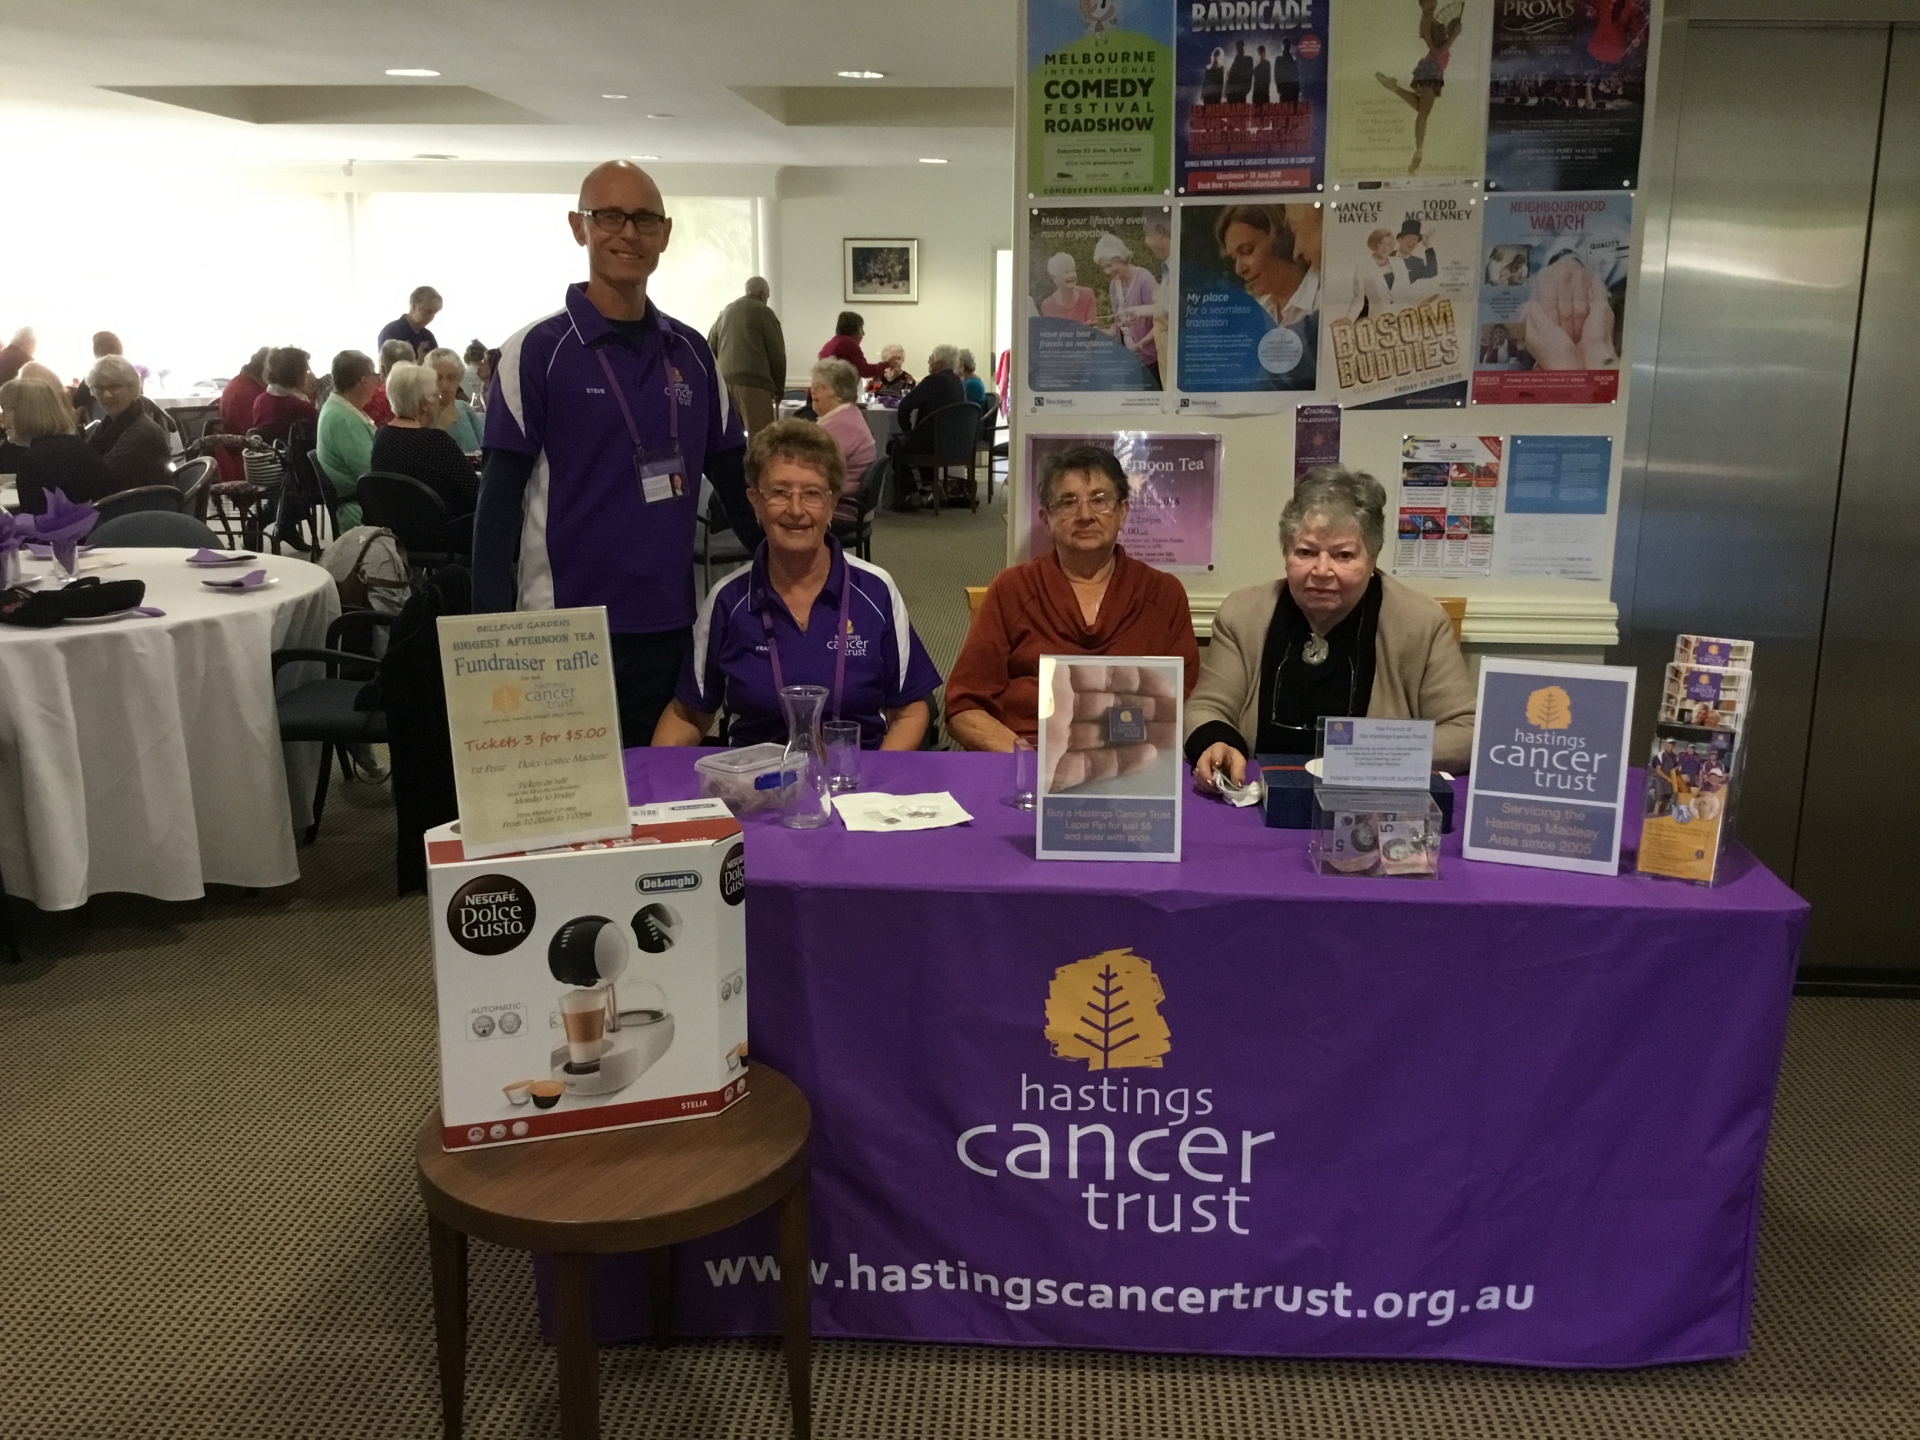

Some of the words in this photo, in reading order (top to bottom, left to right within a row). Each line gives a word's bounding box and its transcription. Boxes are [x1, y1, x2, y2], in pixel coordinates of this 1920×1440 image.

[1192, 0, 1313, 32] BARRICADE
[1502, 0, 1576, 19] PROMS
[1045, 51, 1156, 65] MELBOURNE
[1044, 67, 1155, 76] INTERNATIONAL
[1044, 78, 1155, 99] COMEDY
[1044, 102, 1154, 115] FESTIVAL
[1044, 117, 1154, 133] ROADSHOW
[1184, 160, 1200, 168] SONGS
[1200, 160, 1213, 168] FROM
[1244, 158, 1266, 166] GREATEST
[1267, 157, 1289, 165] MUSICALS
[1216, 172, 1244, 180] Glasshouse
[1257, 171, 1269, 179] June
[1197, 182, 1211, 190] Book
[1211, 181, 1224, 189] Now
[1335, 201, 1383, 213] NANCYE
[1422, 200, 1457, 210] TODD
[1510, 201, 1606, 215] NEIGHBOURHOOD
[1041, 216, 1065, 227] Make
[1066, 217, 1088, 229] your
[1089, 215, 1124, 228] lifestyle
[1125, 216, 1147, 226] even
[1339, 212, 1378, 223] HAYES
[1405, 210, 1473, 222] MCKENNEY
[1530, 214, 1585, 231] WATCH
[1041, 230, 1065, 239] more
[1589, 240, 1620, 250] QUALITY
[1187, 293, 1201, 305] My
[1202, 291, 1229, 305] place
[1185, 305, 1199, 318] for
[1200, 307, 1207, 315] a
[1209, 305, 1252, 315] seamless
[1186, 318, 1229, 328] transition
[1330, 299, 1456, 358] BOSOM
[1040, 331, 1059, 339] Have
[1059, 332, 1075, 341] your
[1076, 330, 1091, 338] best
[1039, 339, 1064, 350] friends
[1075, 339, 1114, 349] neighbours
[1336, 335, 1460, 389] BUDDIES
[585, 387, 606, 395] STEVE
[1353, 380, 1398, 395] GLASSHOUSE
[1399, 375, 1418, 386] PORT
[1394, 383, 1418, 394] FRIDAY
[1429, 377, 1445, 386] JUNE
[663, 387, 694, 399] cncer
[1304, 407, 1334, 415] CHORAL
[1178, 456, 1205, 472] Tea
[476, 622, 524, 634] BELLEVUE
[526, 618, 571, 630] GARDENS
[452, 638, 501, 652] BIGGEST
[506, 633, 569, 647] AFTERNOON
[574, 631, 596, 642] TEA
[454, 652, 546, 678] Fundraiser
[556, 649, 600, 673] raffle
[1698, 656, 1726, 664] cancer
[534, 682, 567, 691] hastings
[1689, 686, 1718, 695] cancer
[524, 687, 577, 703] cancer
[546, 698, 575, 709] trust
[463, 735, 521, 753] Tickets
[523, 733, 536, 746] 3
[539, 731, 562, 748] for
[565, 726, 607, 743] $5.00
[1514, 727, 1587, 752] hastings
[470, 765, 484, 775] 1st
[484, 762, 508, 774] Prize
[517, 760, 543, 770] Dolce
[544, 756, 572, 767] Coffee
[572, 751, 610, 763] Machine
[1489, 744, 1608, 773] cancer
[517, 779, 543, 790] Tickets
[543, 779, 554, 787] on
[1533, 768, 1597, 792] trust
[513, 795, 544, 805] Monday
[544, 793, 553, 801] to
[553, 790, 577, 800] Friday
[1046, 808, 1063, 819] Buy
[1066, 810, 1073, 818] a
[1074, 808, 1113, 820] Hastings
[1115, 809, 1147, 819] Cancer
[1148, 809, 1171, 820] Trust
[1501, 802, 1562, 822] Servicing
[1564, 808, 1586, 821] the
[502, 820, 522, 829] From
[1065, 821, 1090, 832] Lapel
[1091, 821, 1107, 830] Pin
[1108, 821, 1121, 830] for
[1122, 821, 1139, 832] just
[1140, 821, 1153, 831] $5
[1380, 823, 1394, 833] 5
[1484, 816, 1542, 834] Hastings
[1544, 822, 1600, 842] Macleay
[1064, 832, 1081, 842] and
[1083, 833, 1104, 842] wear
[1106, 832, 1125, 842] with
[1127, 832, 1152, 845] pride.
[1488, 833, 1519, 847] Area
[1522, 836, 1557, 851] since
[1558, 840, 1593, 855] 2005
[459, 904, 522, 924] Dolce
[461, 919, 524, 940] Gusto
[470, 1002, 522, 1014] AUTOMATIC
[680, 1099, 708, 1111] STELIA
[1020, 1073, 1214, 1127] hastings
[956, 1122, 1277, 1184] cancer
[1081, 1182, 1251, 1235] trust
